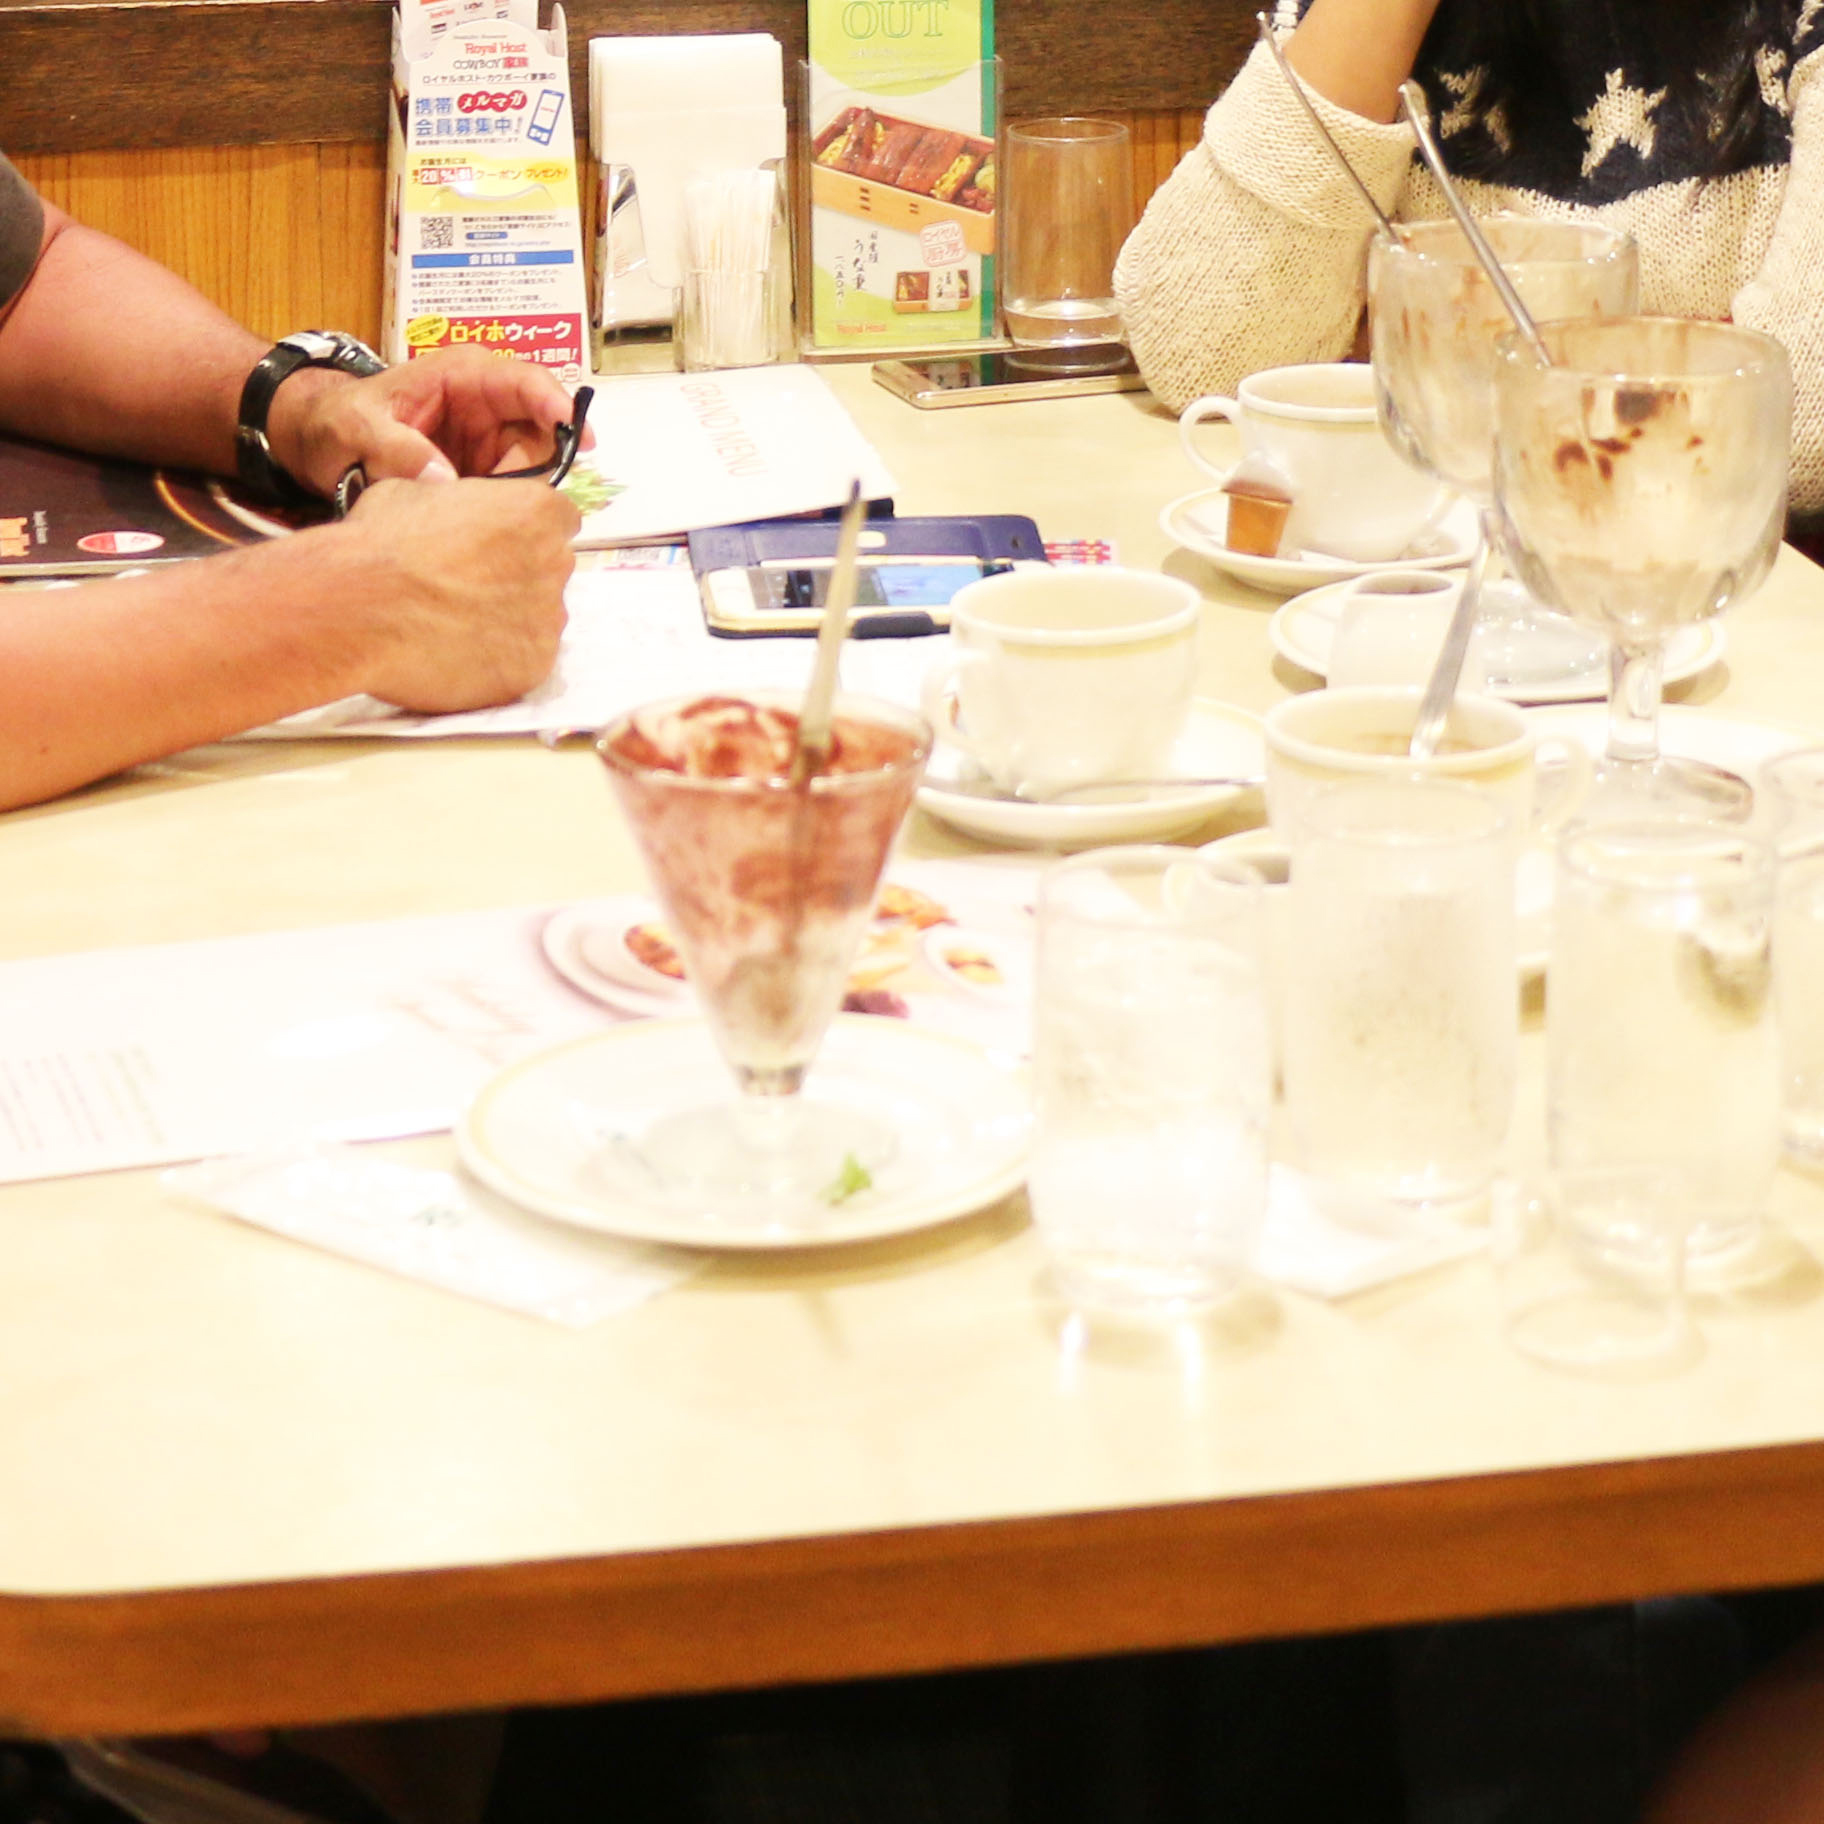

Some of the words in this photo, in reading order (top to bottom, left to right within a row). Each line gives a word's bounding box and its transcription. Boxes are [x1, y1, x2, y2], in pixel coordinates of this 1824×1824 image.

[842, 0, 950, 40] OUT
[464, 42, 497, 56] Royal
[500, 42, 528, 54] Host
[459, 91, 526, 112] メルマガ
[415, 117, 523, 137] 会員募集中!
[450, 319, 573, 342] ロイホウィーク
[680, 382, 740, 429] GRAND
[706, 429, 769, 476] MENU
